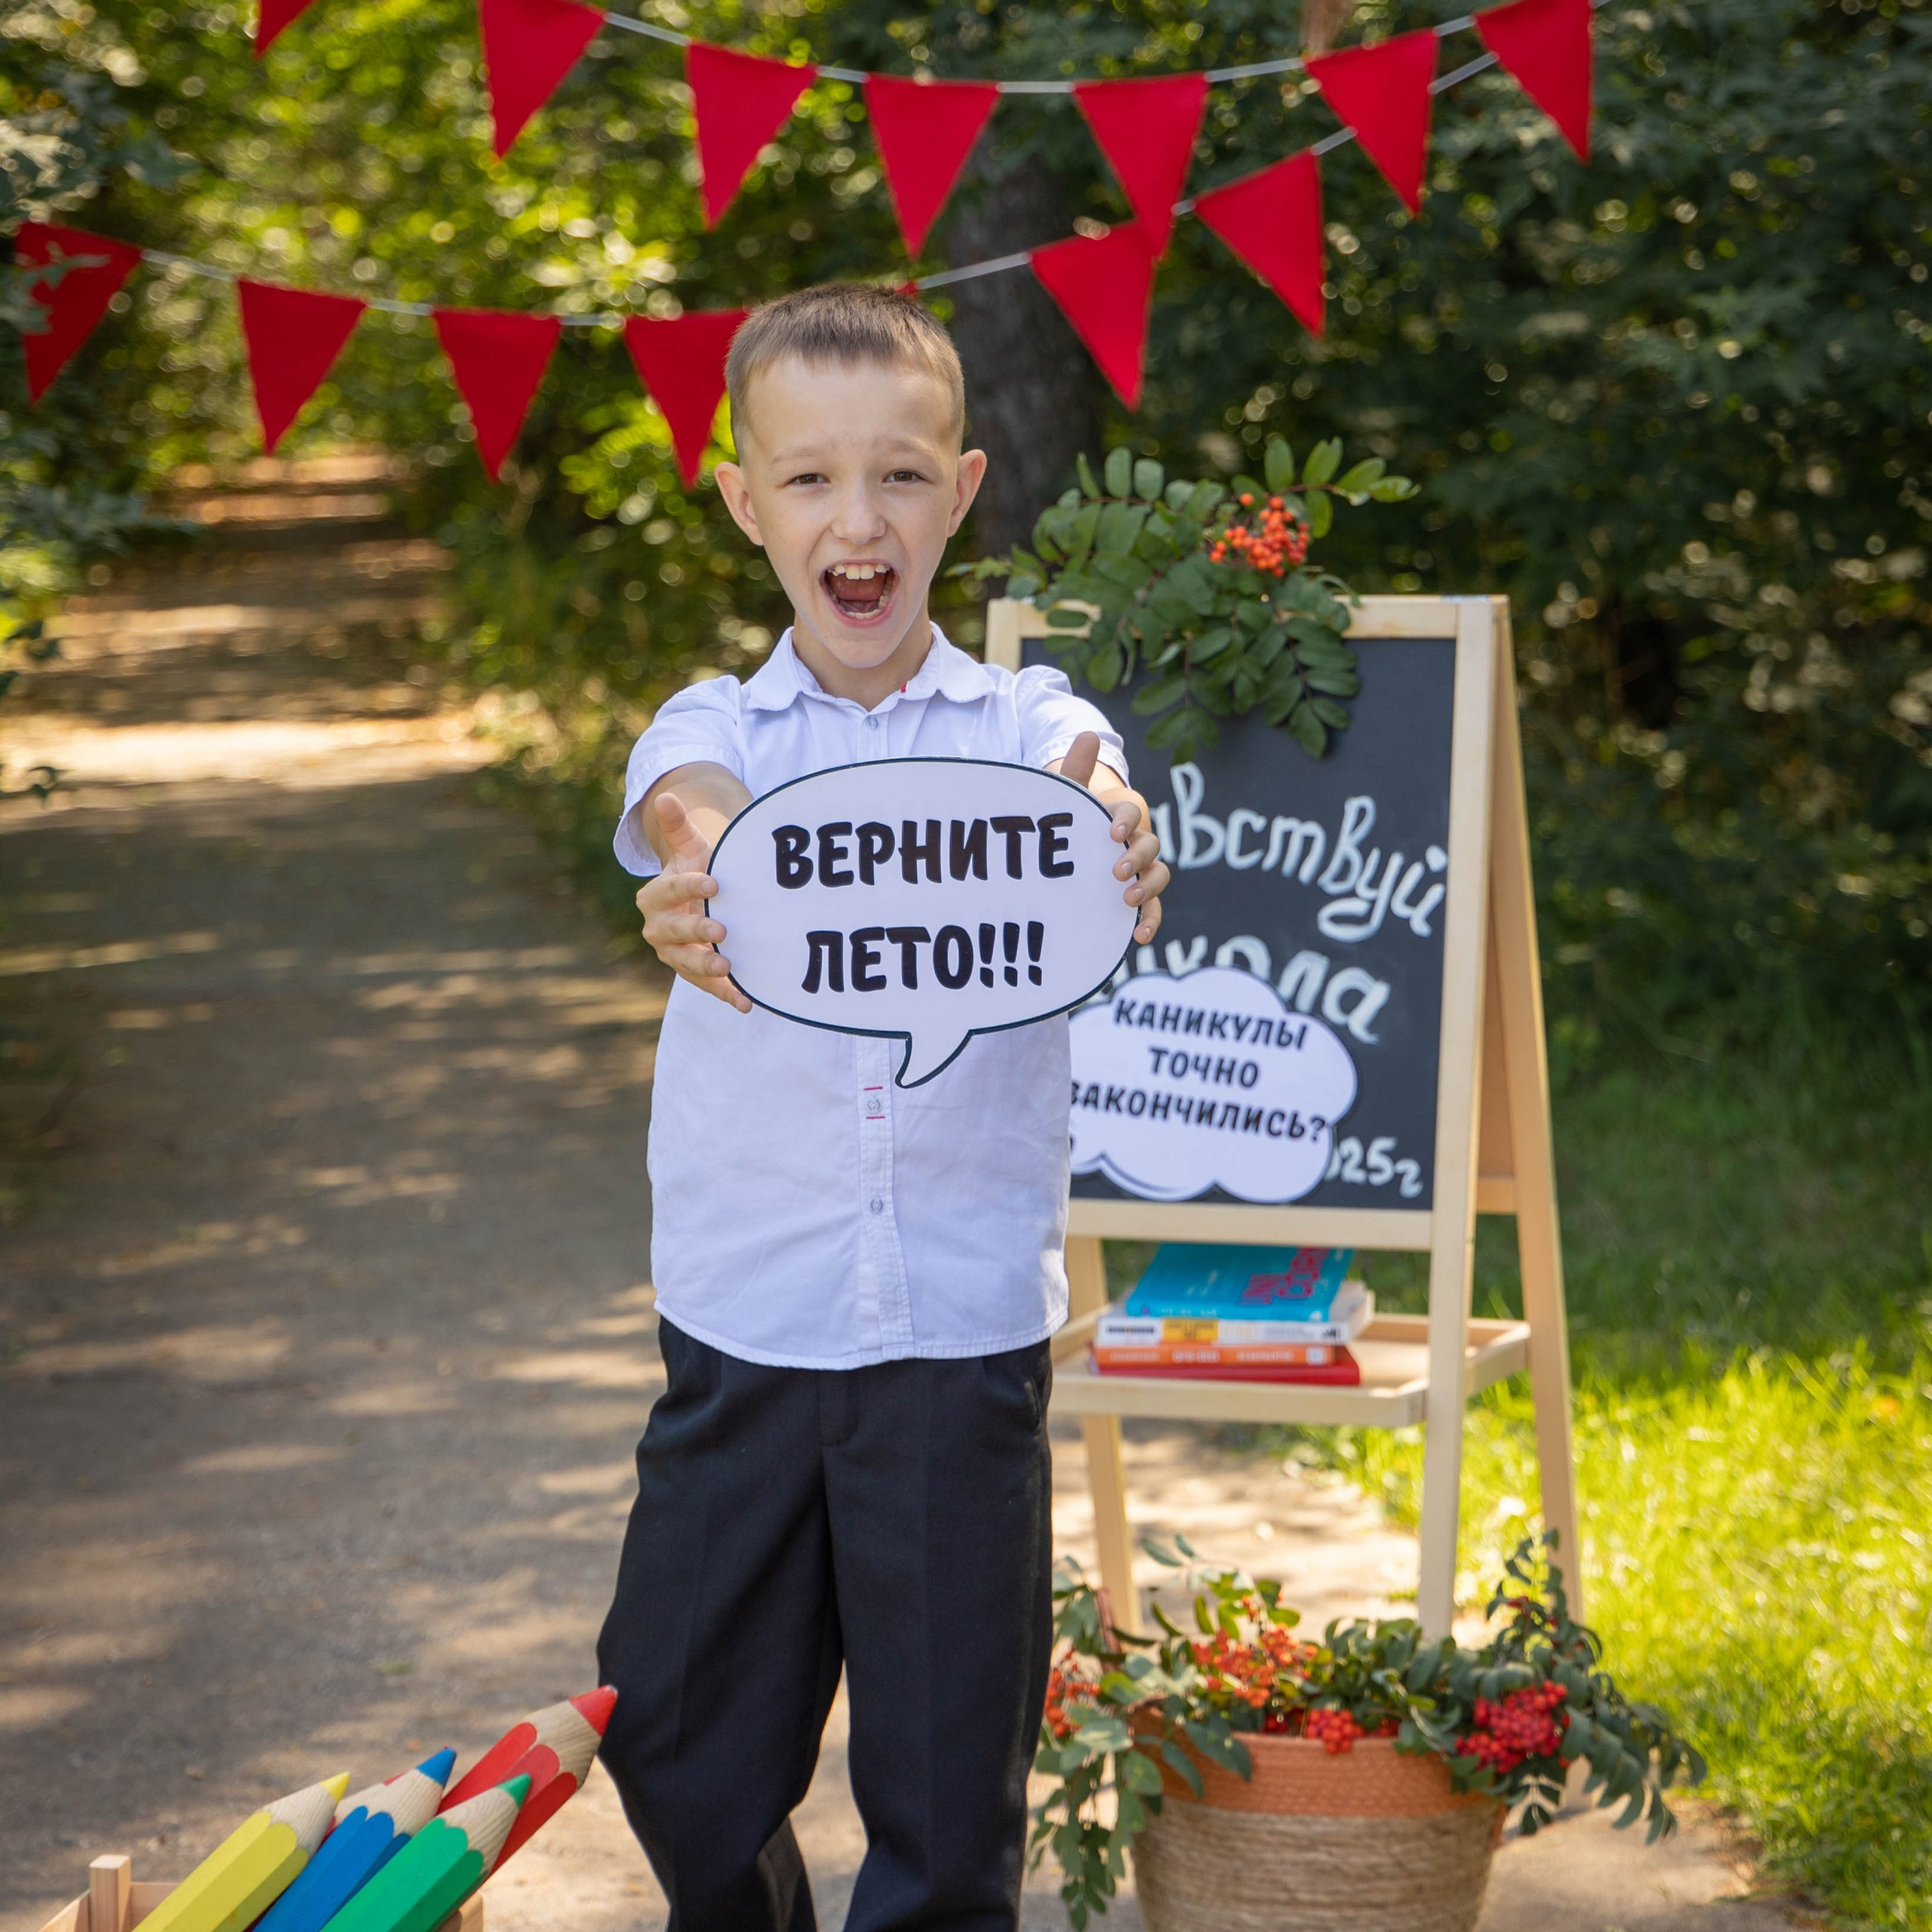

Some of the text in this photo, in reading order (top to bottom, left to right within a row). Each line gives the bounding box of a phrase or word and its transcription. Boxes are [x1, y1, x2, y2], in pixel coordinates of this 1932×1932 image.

[771, 812, 1075, 889] ВЕРНИТЕ
[801, 921, 1044, 994] ЛЕТО!!!
[1114, 999, 1309, 1052] КАНИКУЛЫ
[1150, 1047, 1260, 1088] ТОЧНО
